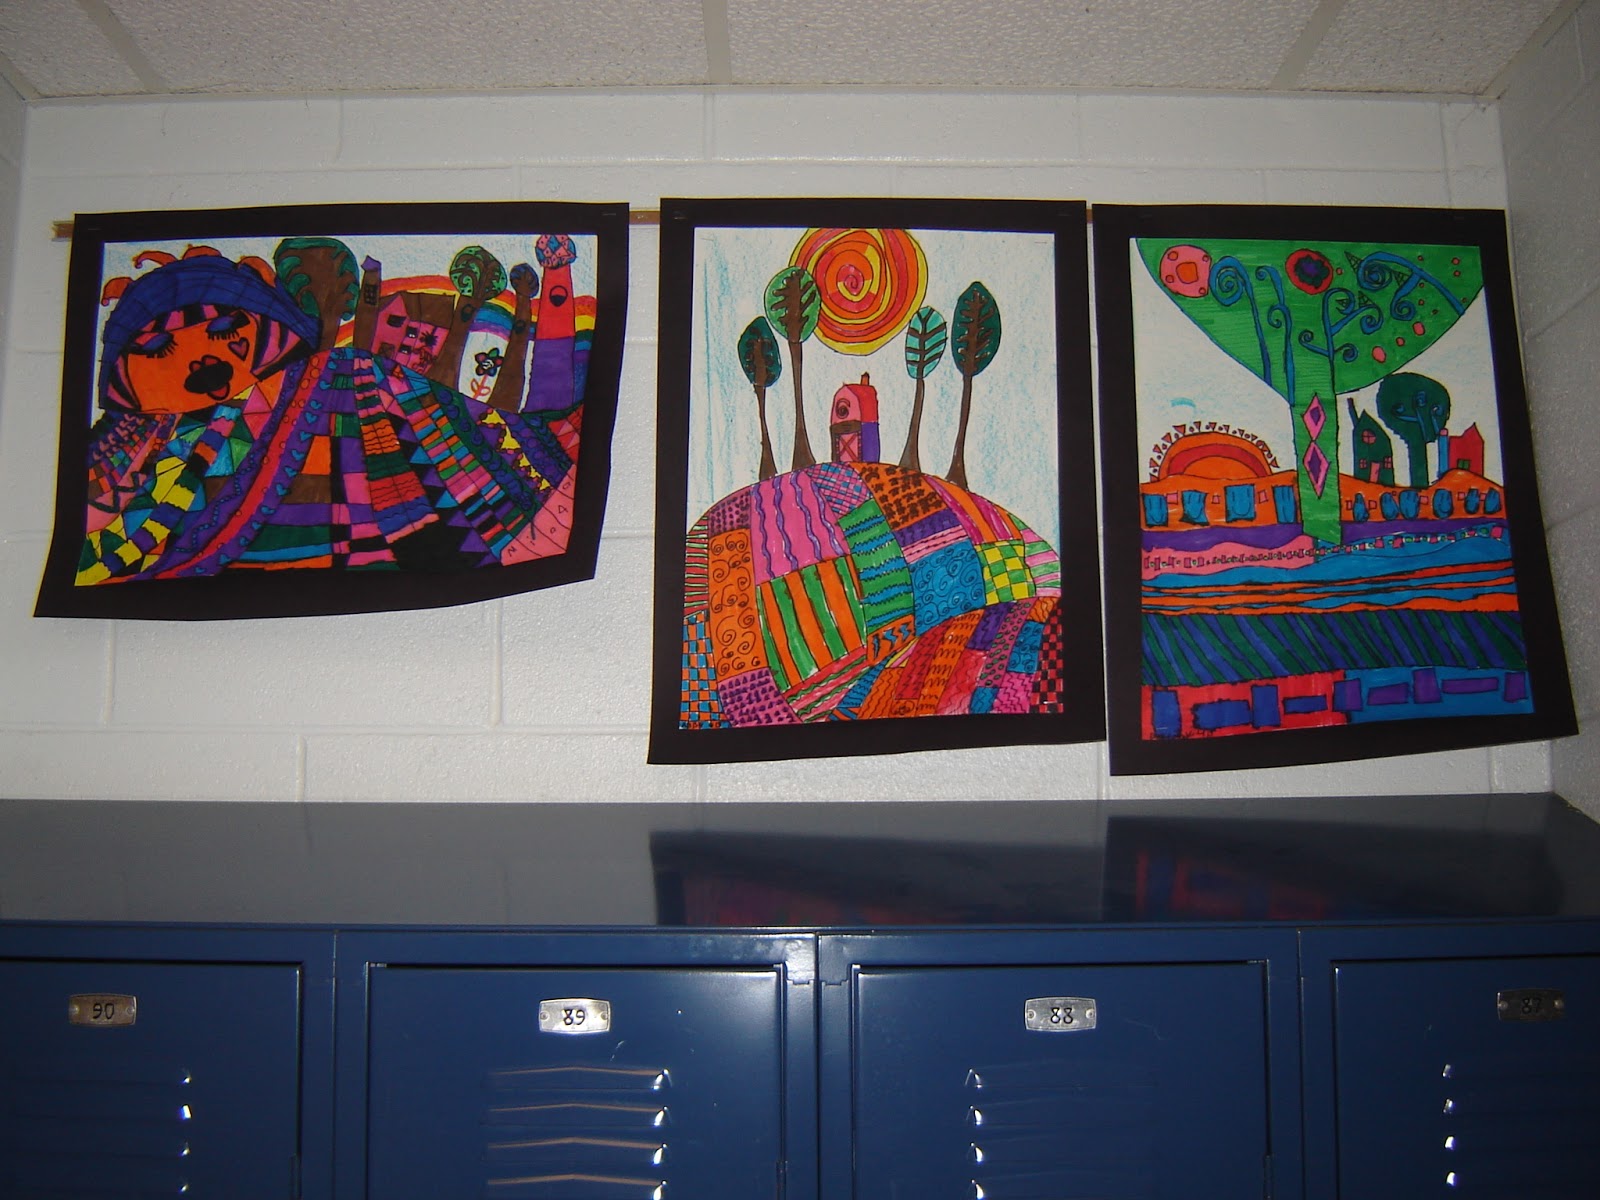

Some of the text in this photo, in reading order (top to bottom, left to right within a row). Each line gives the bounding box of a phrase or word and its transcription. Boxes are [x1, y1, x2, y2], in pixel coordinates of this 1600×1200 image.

[93, 1003, 114, 1019] 90
[1522, 998, 1541, 1014] 87
[563, 1009, 585, 1025] 89
[1051, 1007, 1073, 1024] 88
